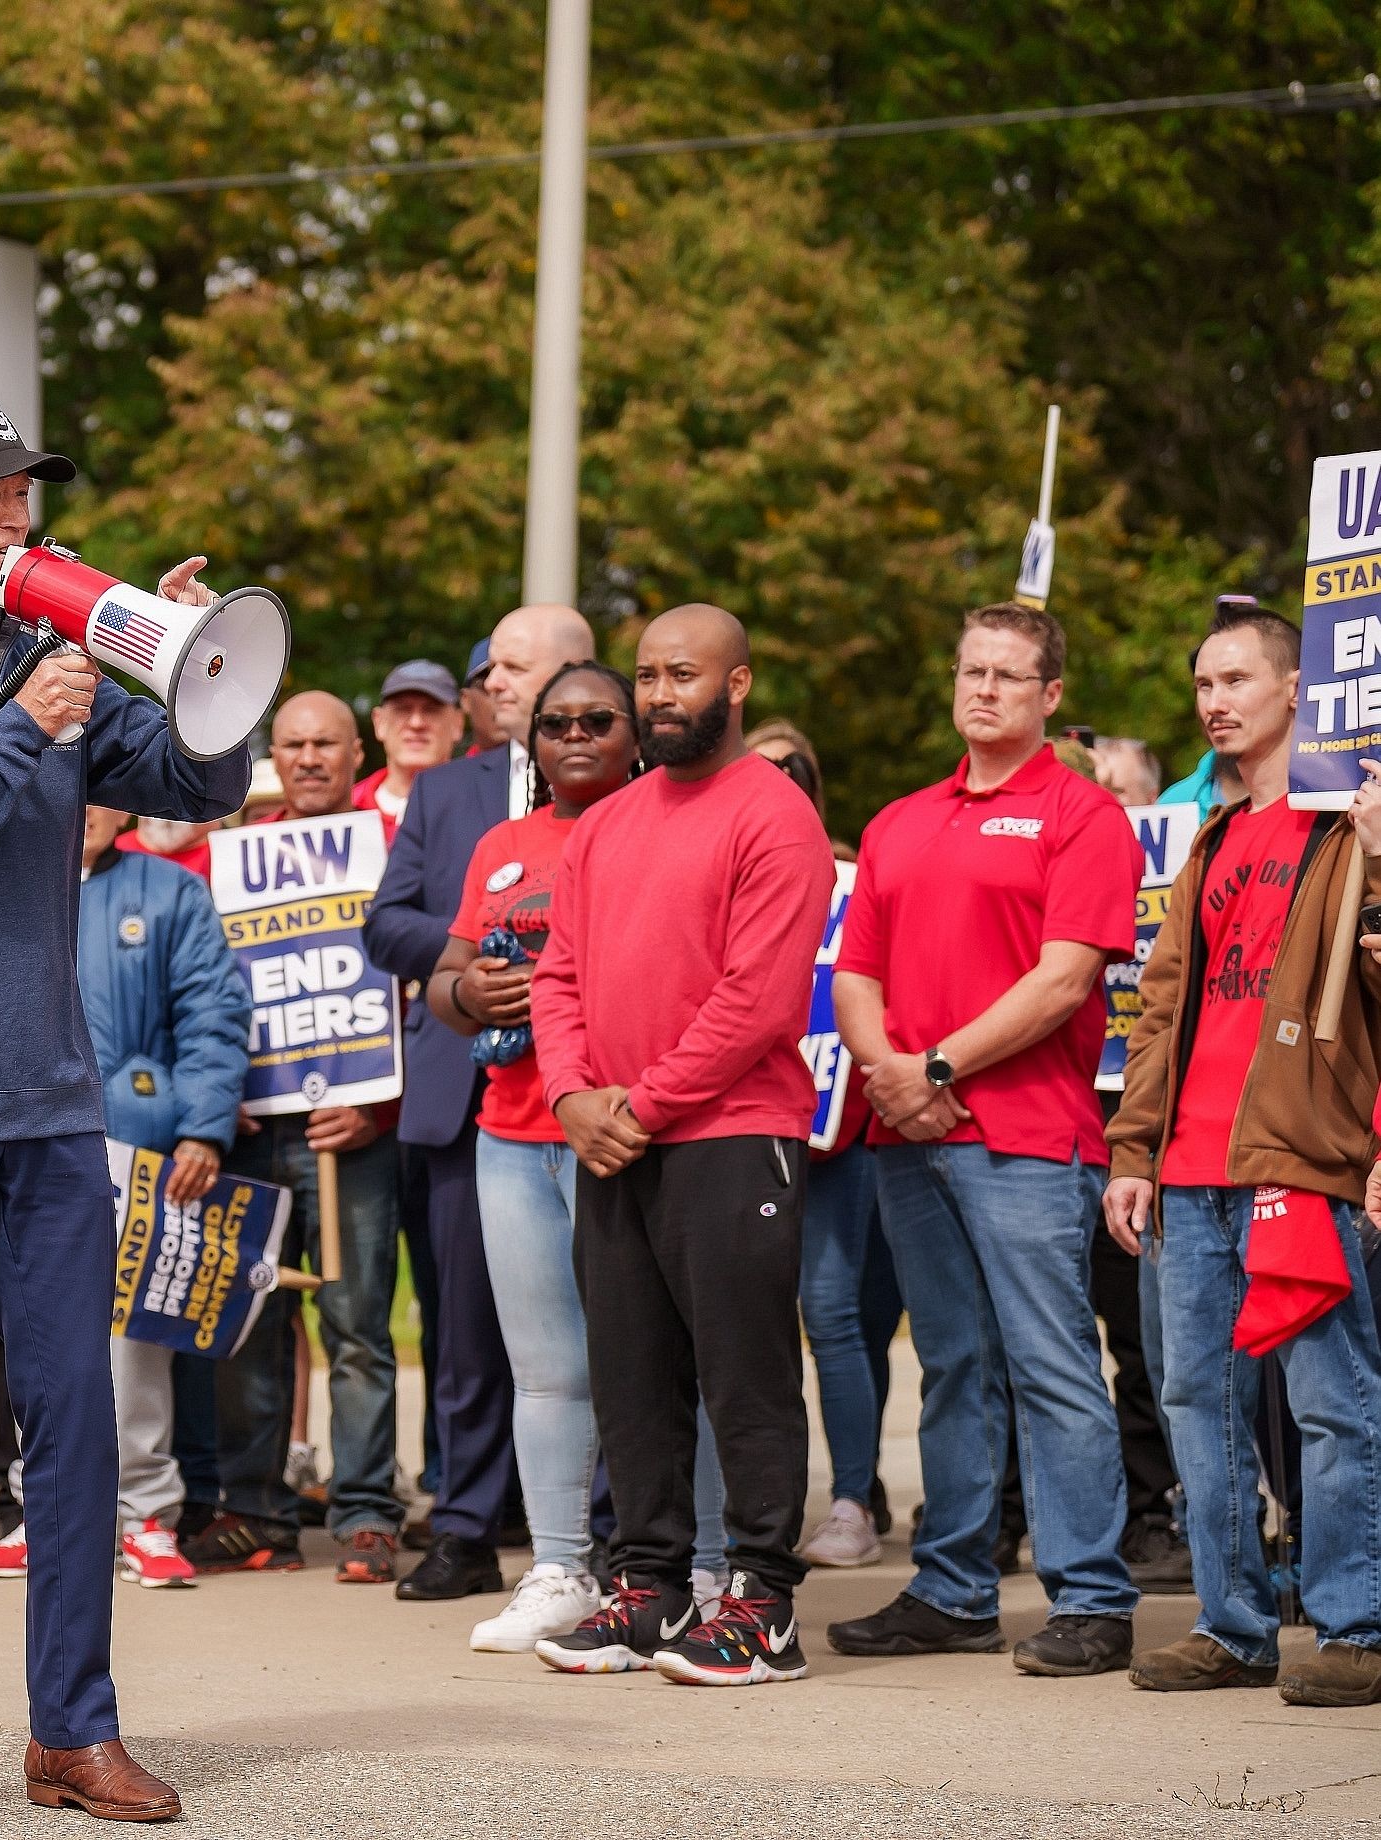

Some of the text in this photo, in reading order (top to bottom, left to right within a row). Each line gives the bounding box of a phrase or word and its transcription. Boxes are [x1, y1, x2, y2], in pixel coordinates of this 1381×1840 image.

[241, 826, 352, 893] UAW
[1259, 860, 1297, 888] ON
[229, 907, 325, 942] STAND
[512, 908, 550, 935] UA
[250, 944, 364, 1003] END
[248, 988, 391, 1052] TIERS
[113, 1164, 151, 1326] STAND UP
[184, 1204, 224, 1321] RECORD
[194, 1185, 253, 1350] CONTRACTS
